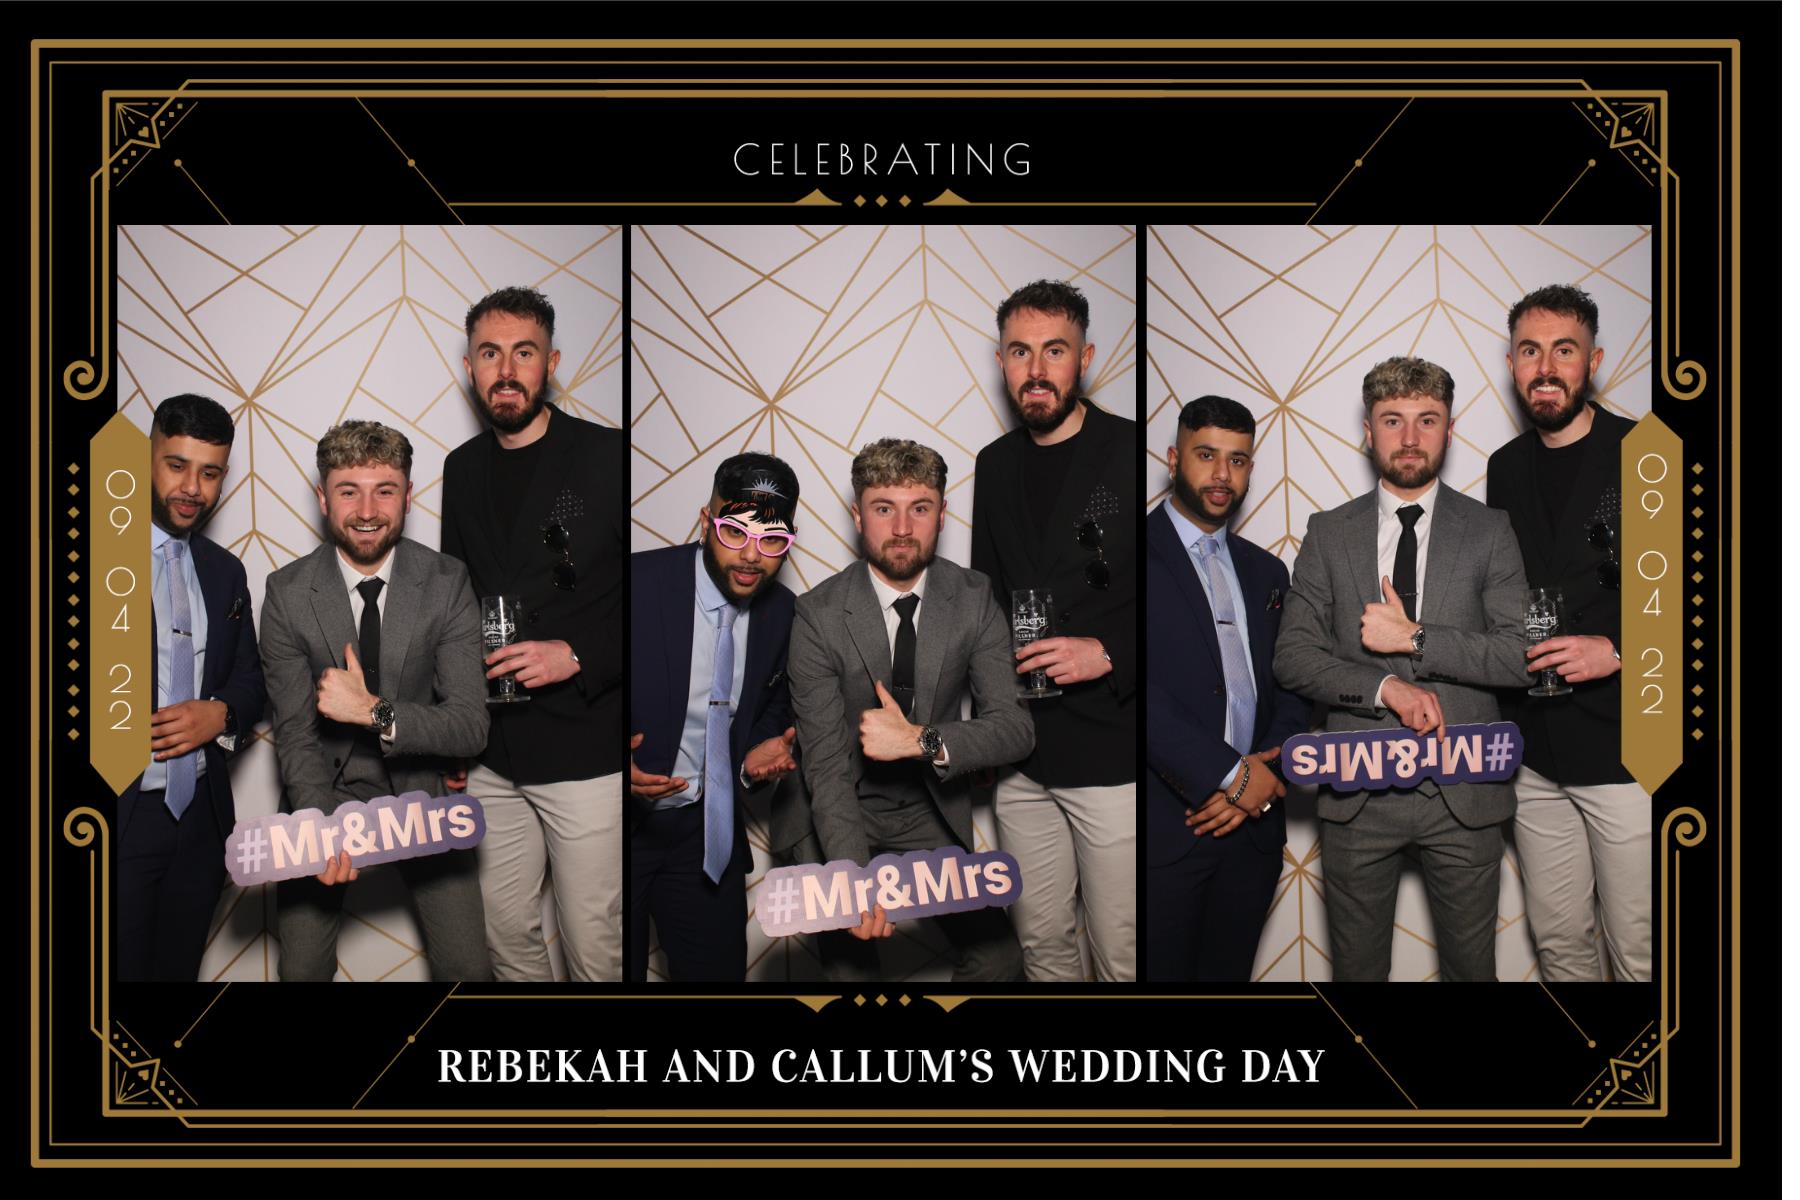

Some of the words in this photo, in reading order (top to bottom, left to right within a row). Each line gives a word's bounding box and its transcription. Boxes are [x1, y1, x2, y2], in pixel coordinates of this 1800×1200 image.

[1291, 732, 1515, 782] #Mr&Mrs
[236, 801, 477, 875] #Mr&Mrs
[767, 856, 1013, 926] #Mr&Mrs
